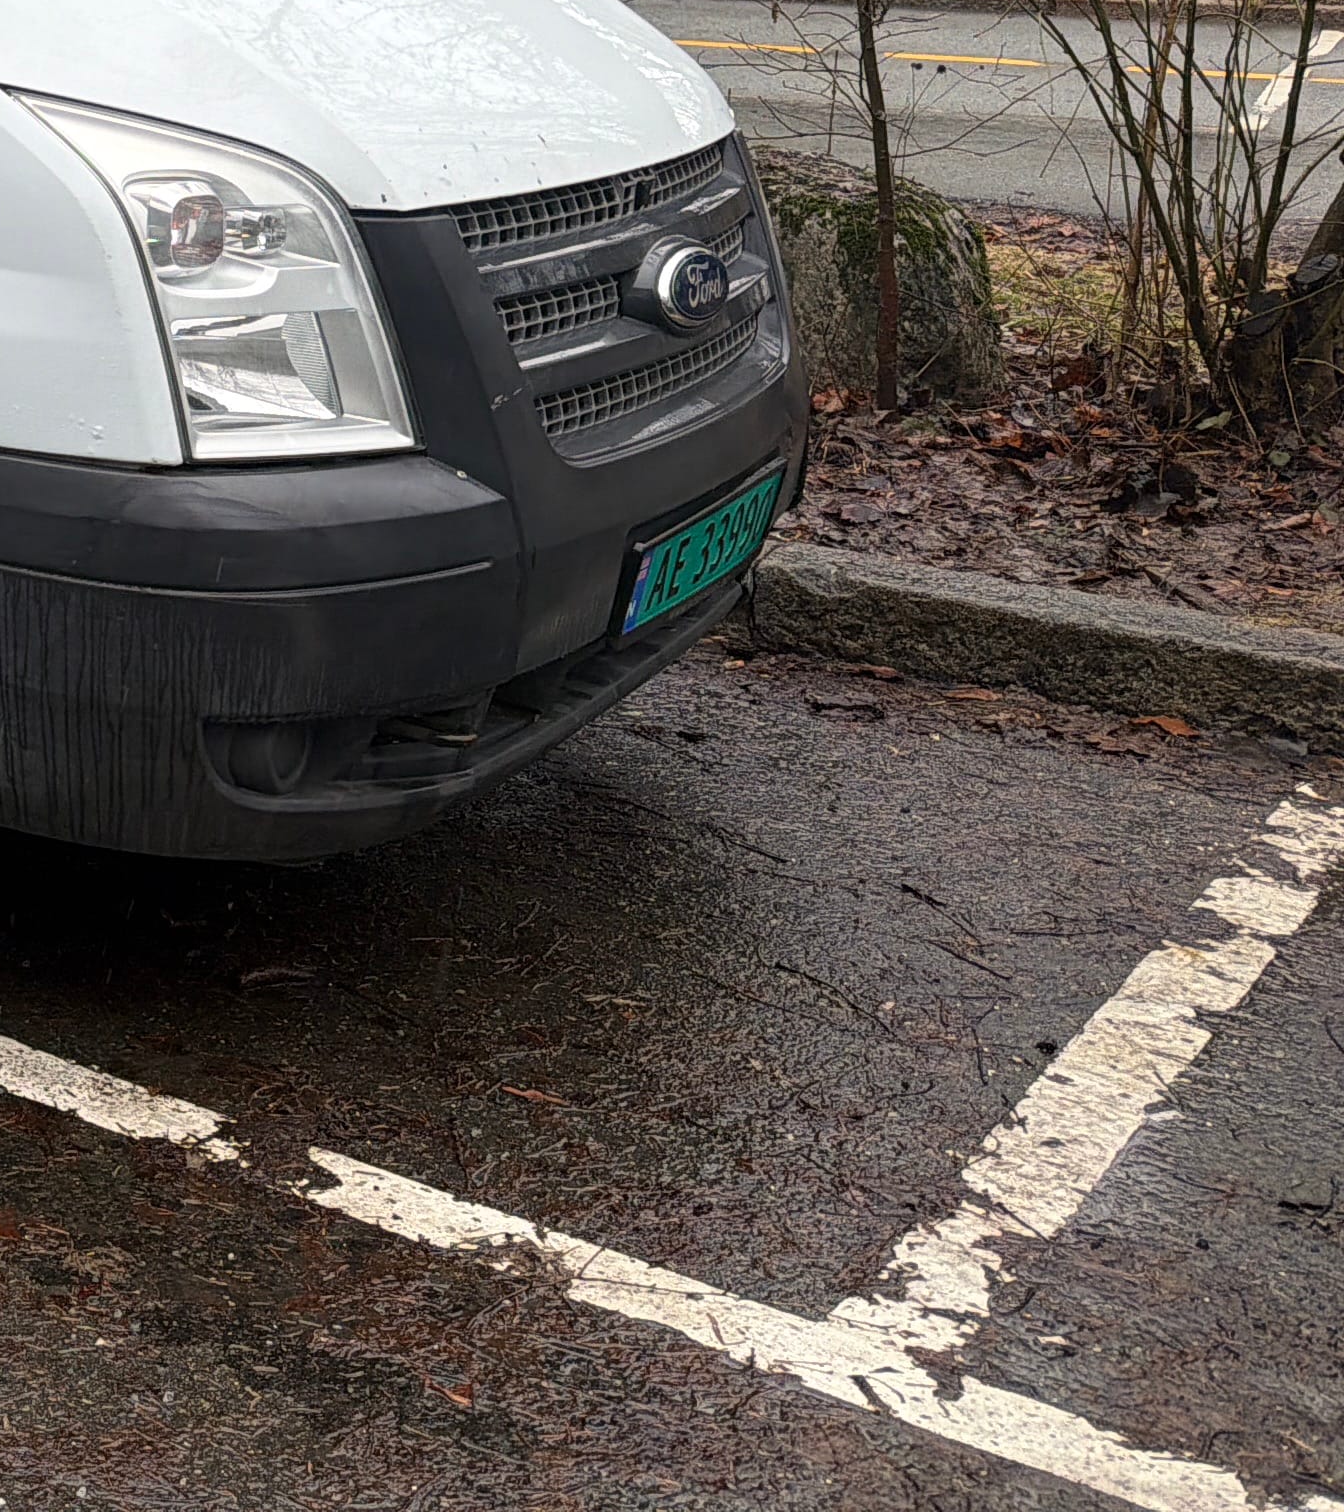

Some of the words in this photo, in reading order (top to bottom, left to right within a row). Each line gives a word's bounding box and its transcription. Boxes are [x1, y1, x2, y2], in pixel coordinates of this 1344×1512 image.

[686, 261, 723, 309] Ford
[645, 534, 692, 612] AE
[692, 484, 775, 585] 33990
